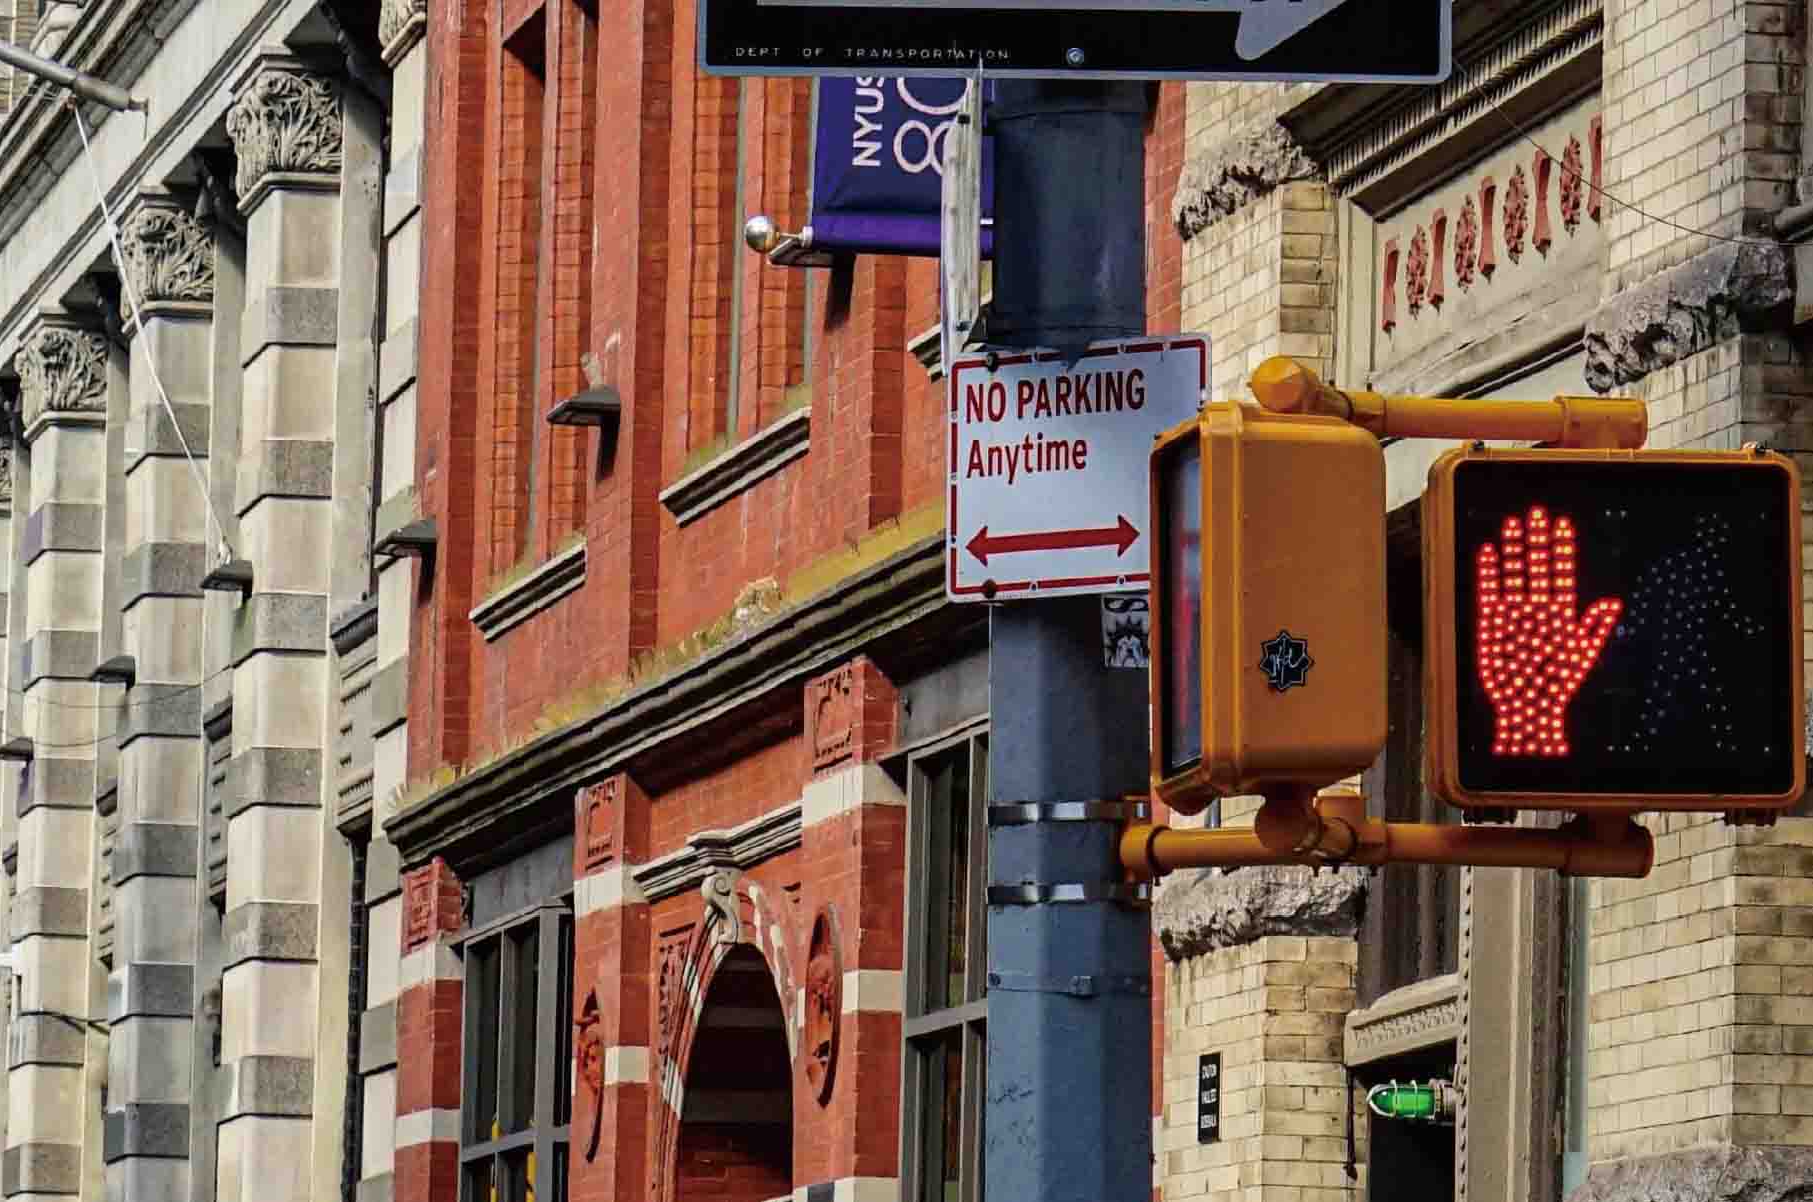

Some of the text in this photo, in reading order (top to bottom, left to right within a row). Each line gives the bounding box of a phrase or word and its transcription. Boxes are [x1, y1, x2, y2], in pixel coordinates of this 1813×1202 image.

[735, 47, 1010, 60] DEPT OF TRANSPORTATION
[966, 368, 1146, 424] NO PARKING
[966, 432, 1088, 486] Anytime
